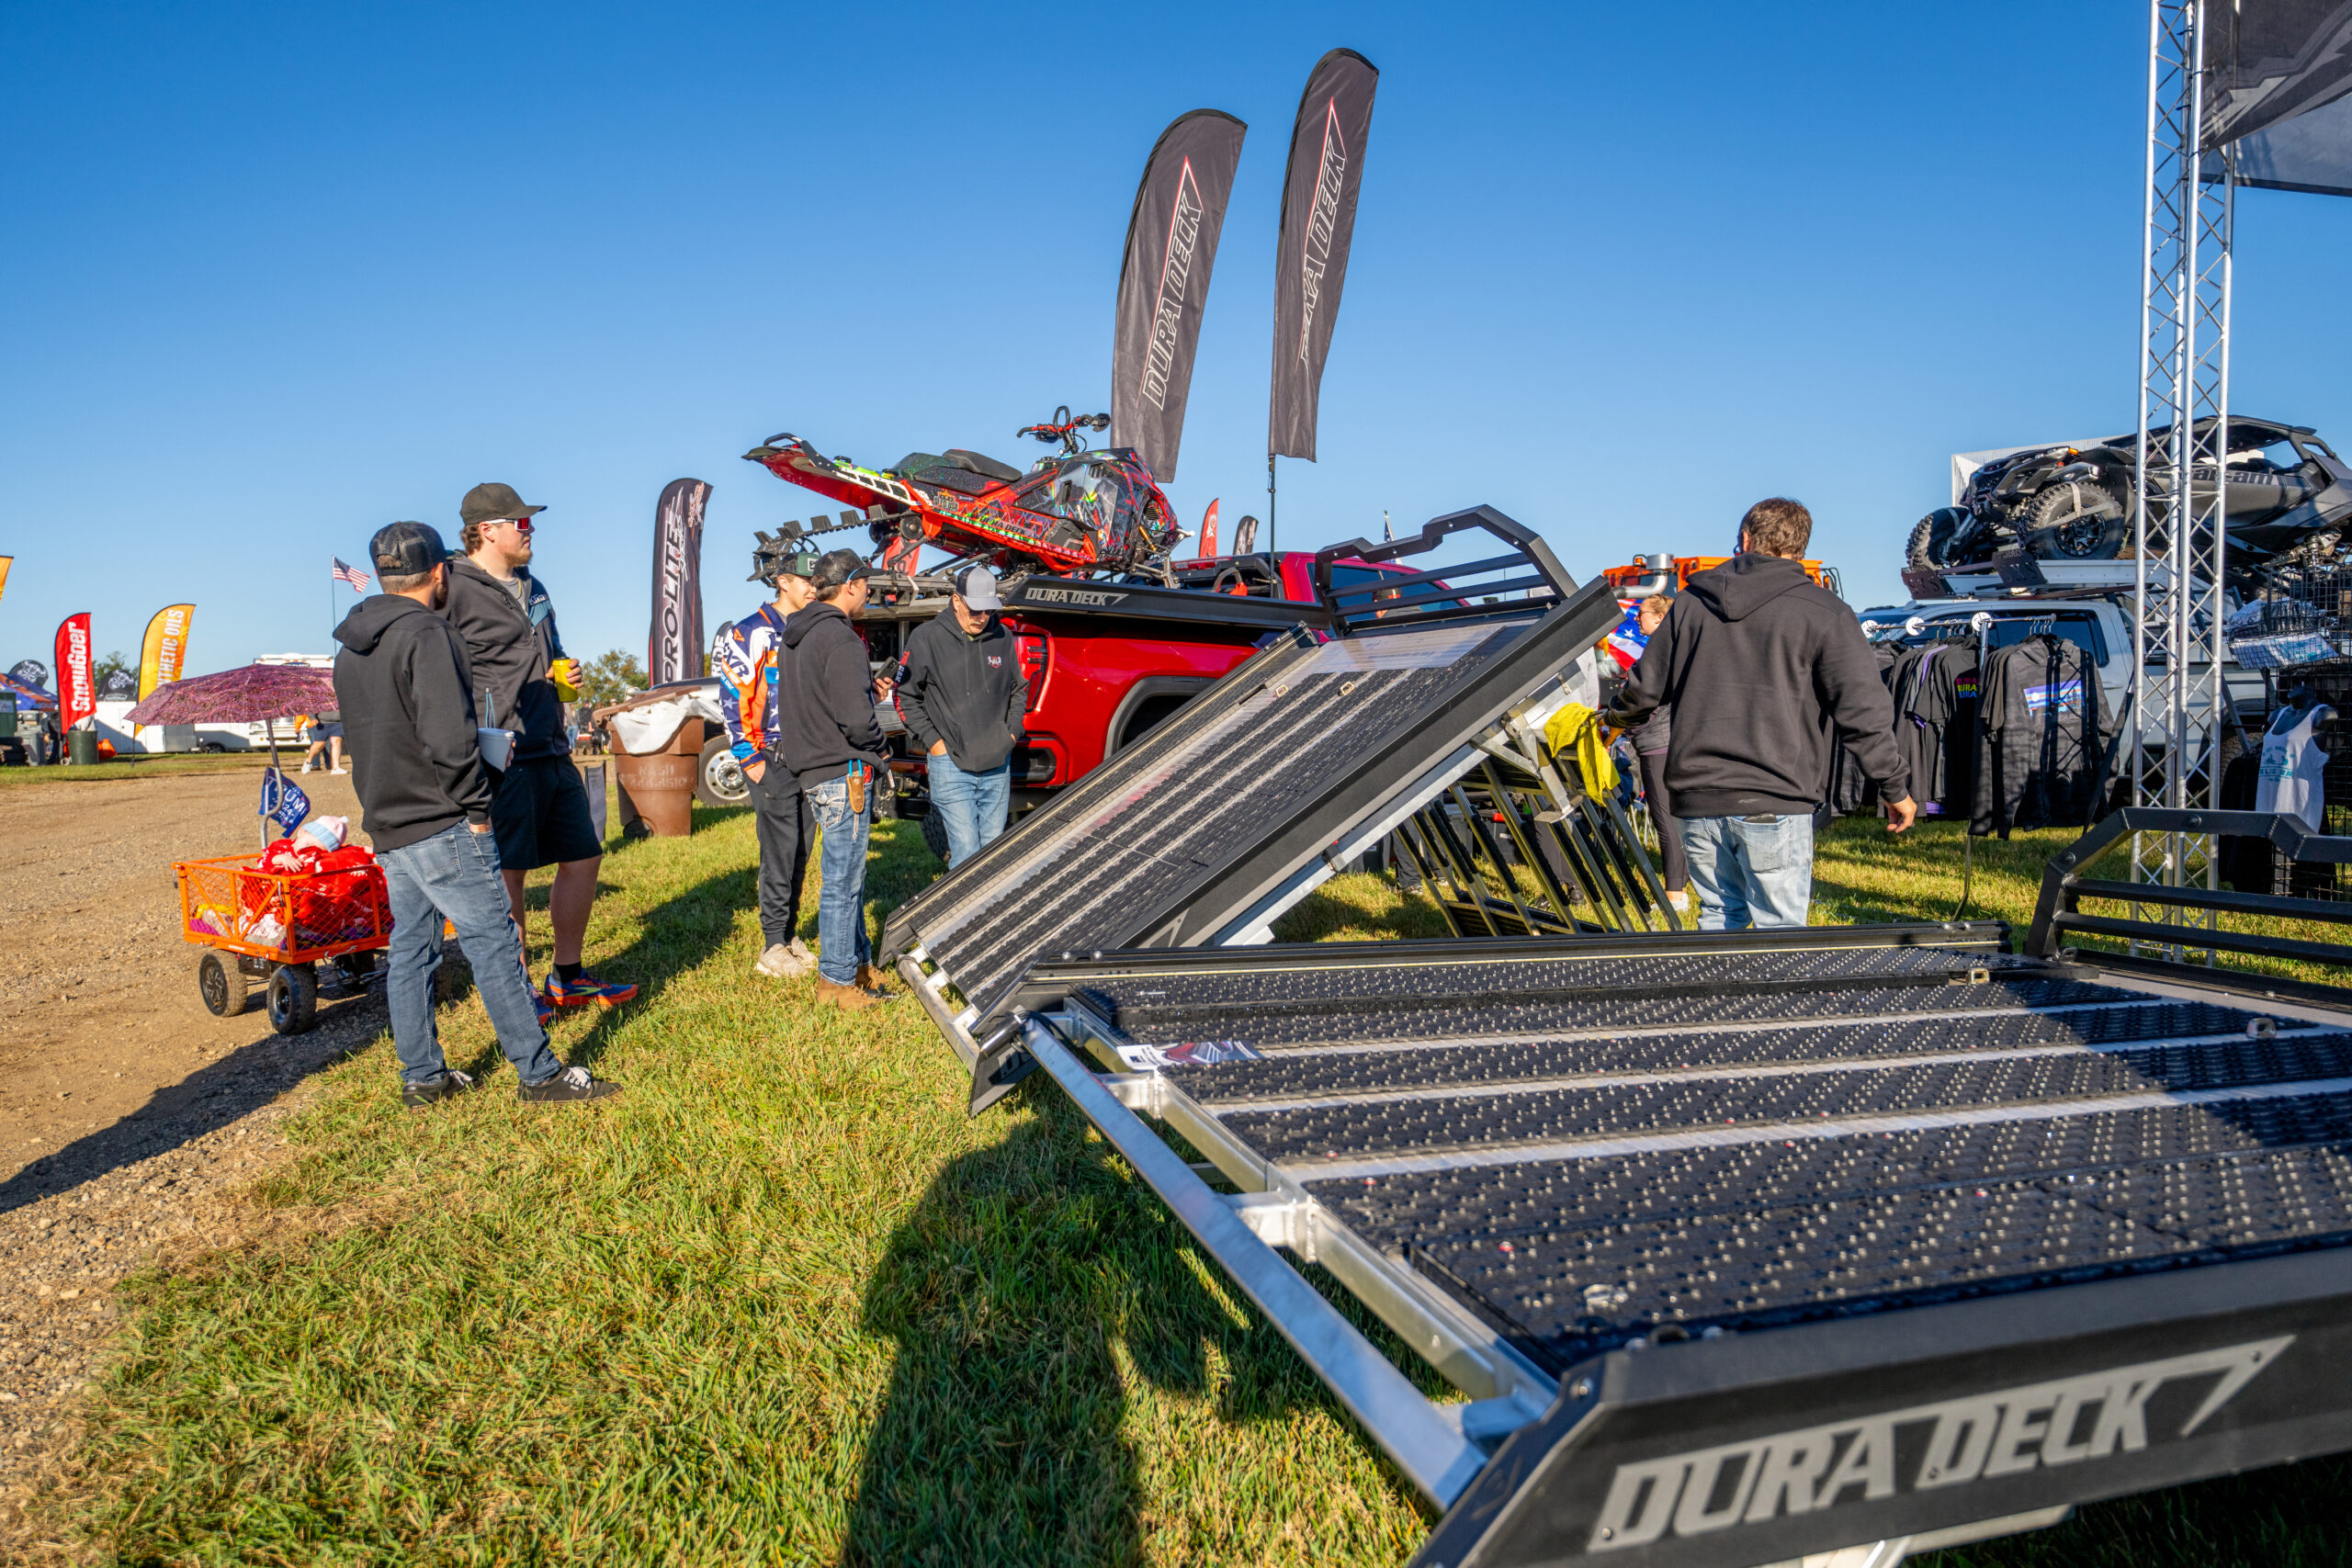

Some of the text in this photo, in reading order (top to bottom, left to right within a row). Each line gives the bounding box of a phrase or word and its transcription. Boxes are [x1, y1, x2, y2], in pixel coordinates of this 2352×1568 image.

[1310, 135, 1345, 258] DECK
[1143, 191, 1202, 411] DURA DECK
[157, 609, 185, 688] NTHETIC OILS
[662, 519, 681, 683] PRO-LITE
[1025, 587, 1107, 606] DURA DECK
[1586, 1380, 2161, 1554] DURA DECK
